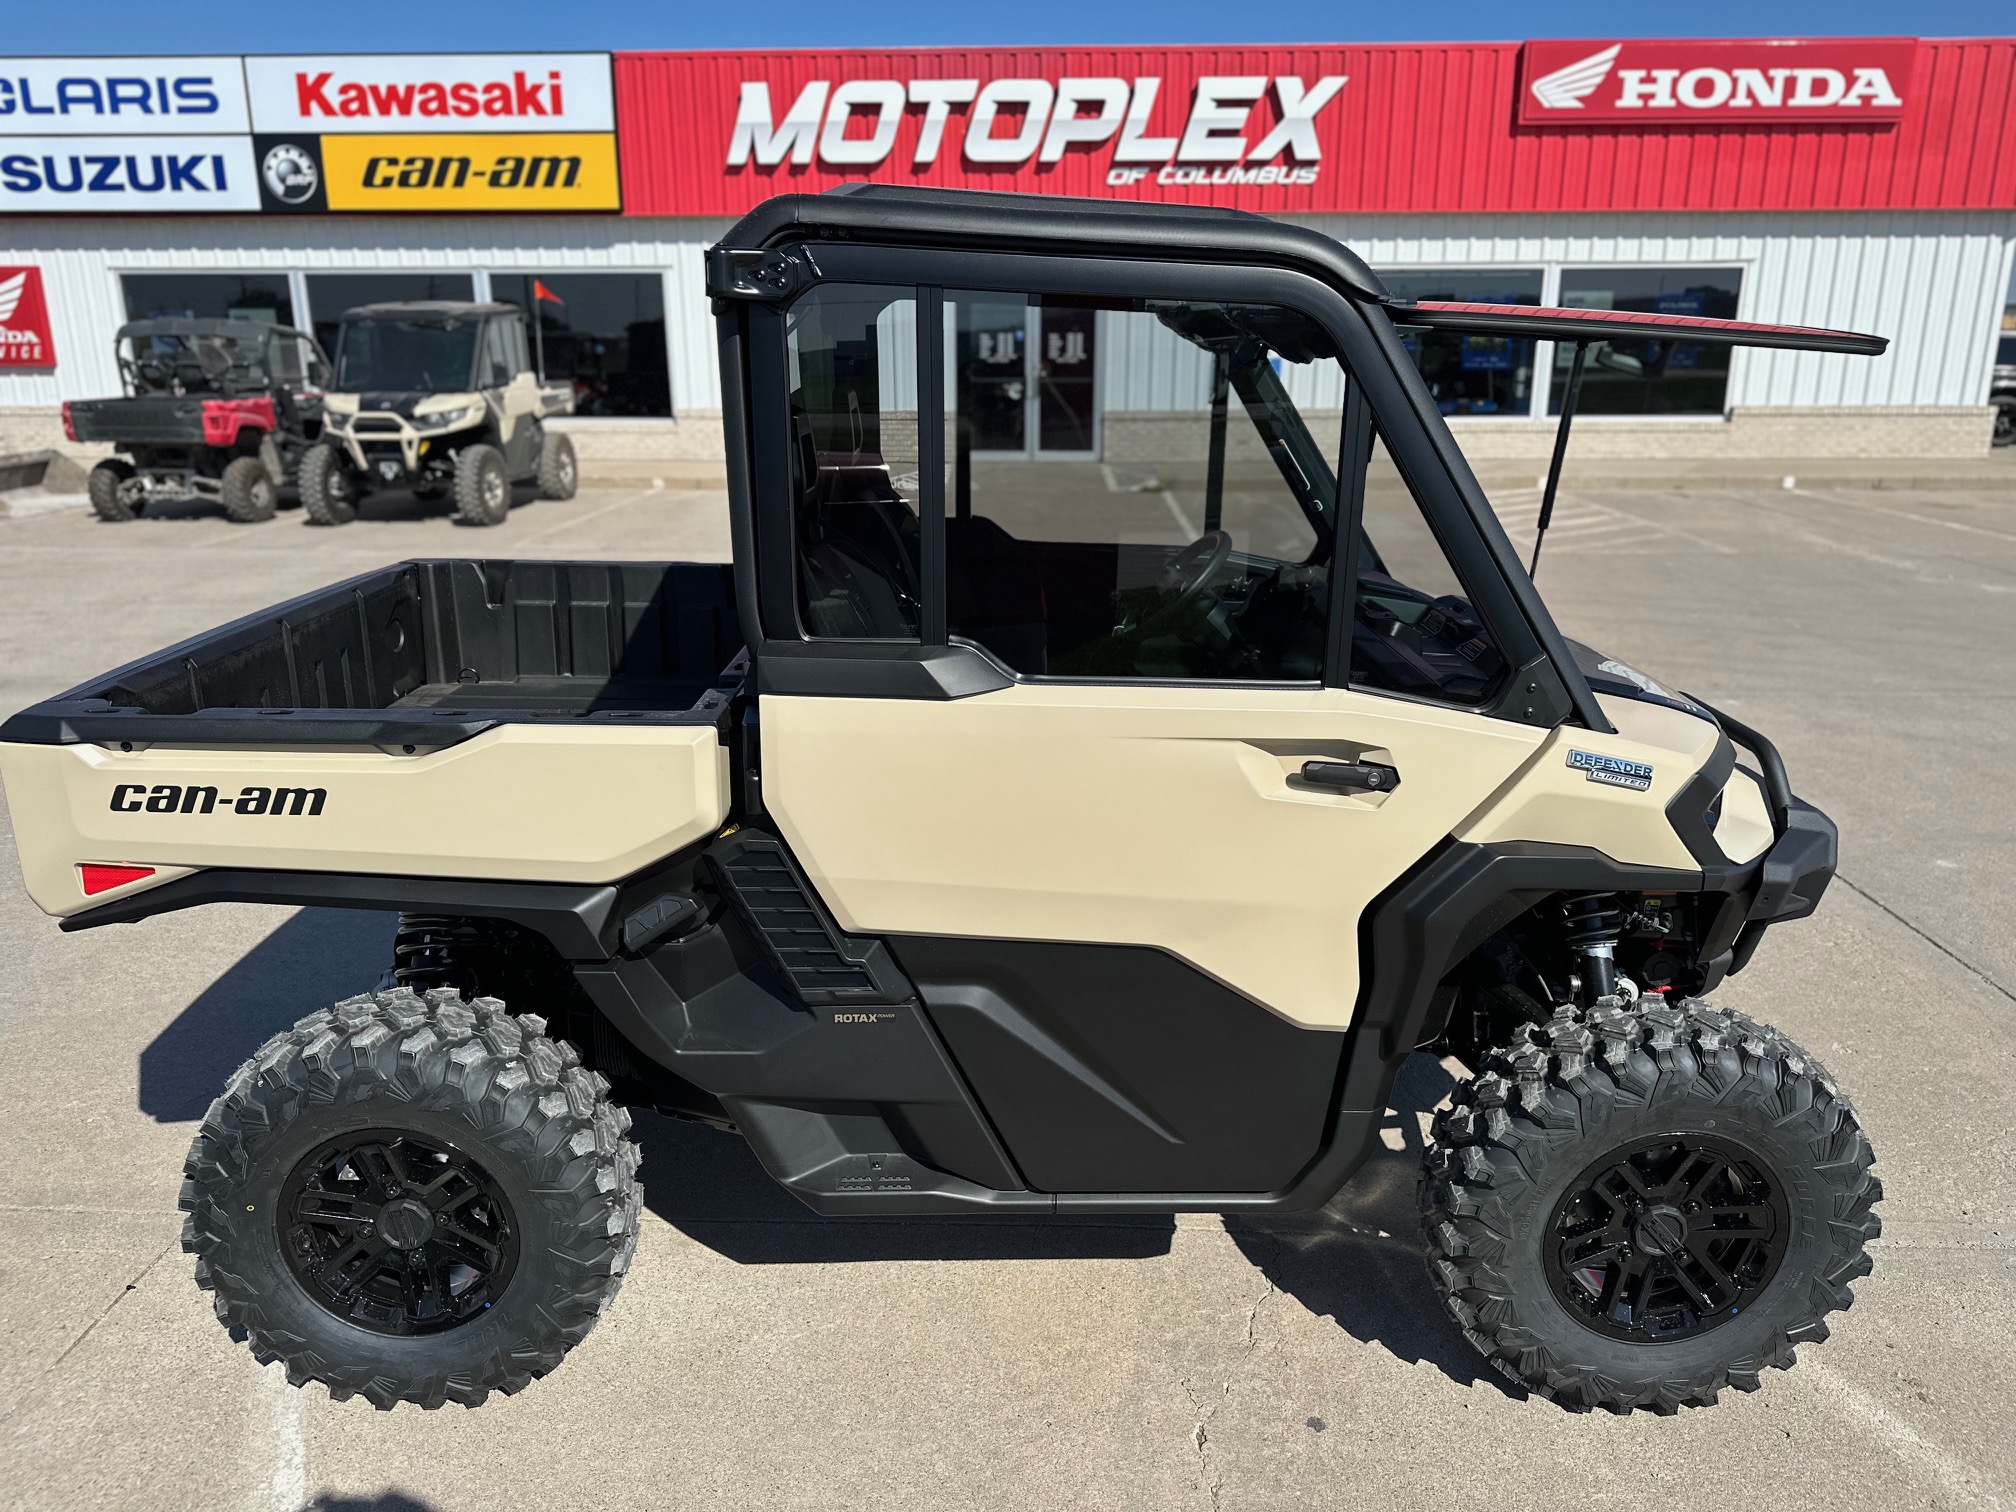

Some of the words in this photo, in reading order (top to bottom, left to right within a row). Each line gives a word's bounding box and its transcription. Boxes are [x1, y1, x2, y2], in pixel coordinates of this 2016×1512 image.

[295, 71, 564, 118] Kawasaki
[1614, 67, 1904, 108] HONDA
[725, 75, 1349, 166] MOTOPLEX
[1, 153, 228, 193] SUZUKI
[361, 155, 582, 190] can-am
[1106, 165, 1150, 186] OF
[1156, 165, 1321, 186] COLUMBUS
[1573, 752, 1653, 778] DEFENDER
[1594, 771, 1648, 788] LIMITED
[109, 784, 328, 816] can-am
[834, 1013, 878, 1023] ROTAX
